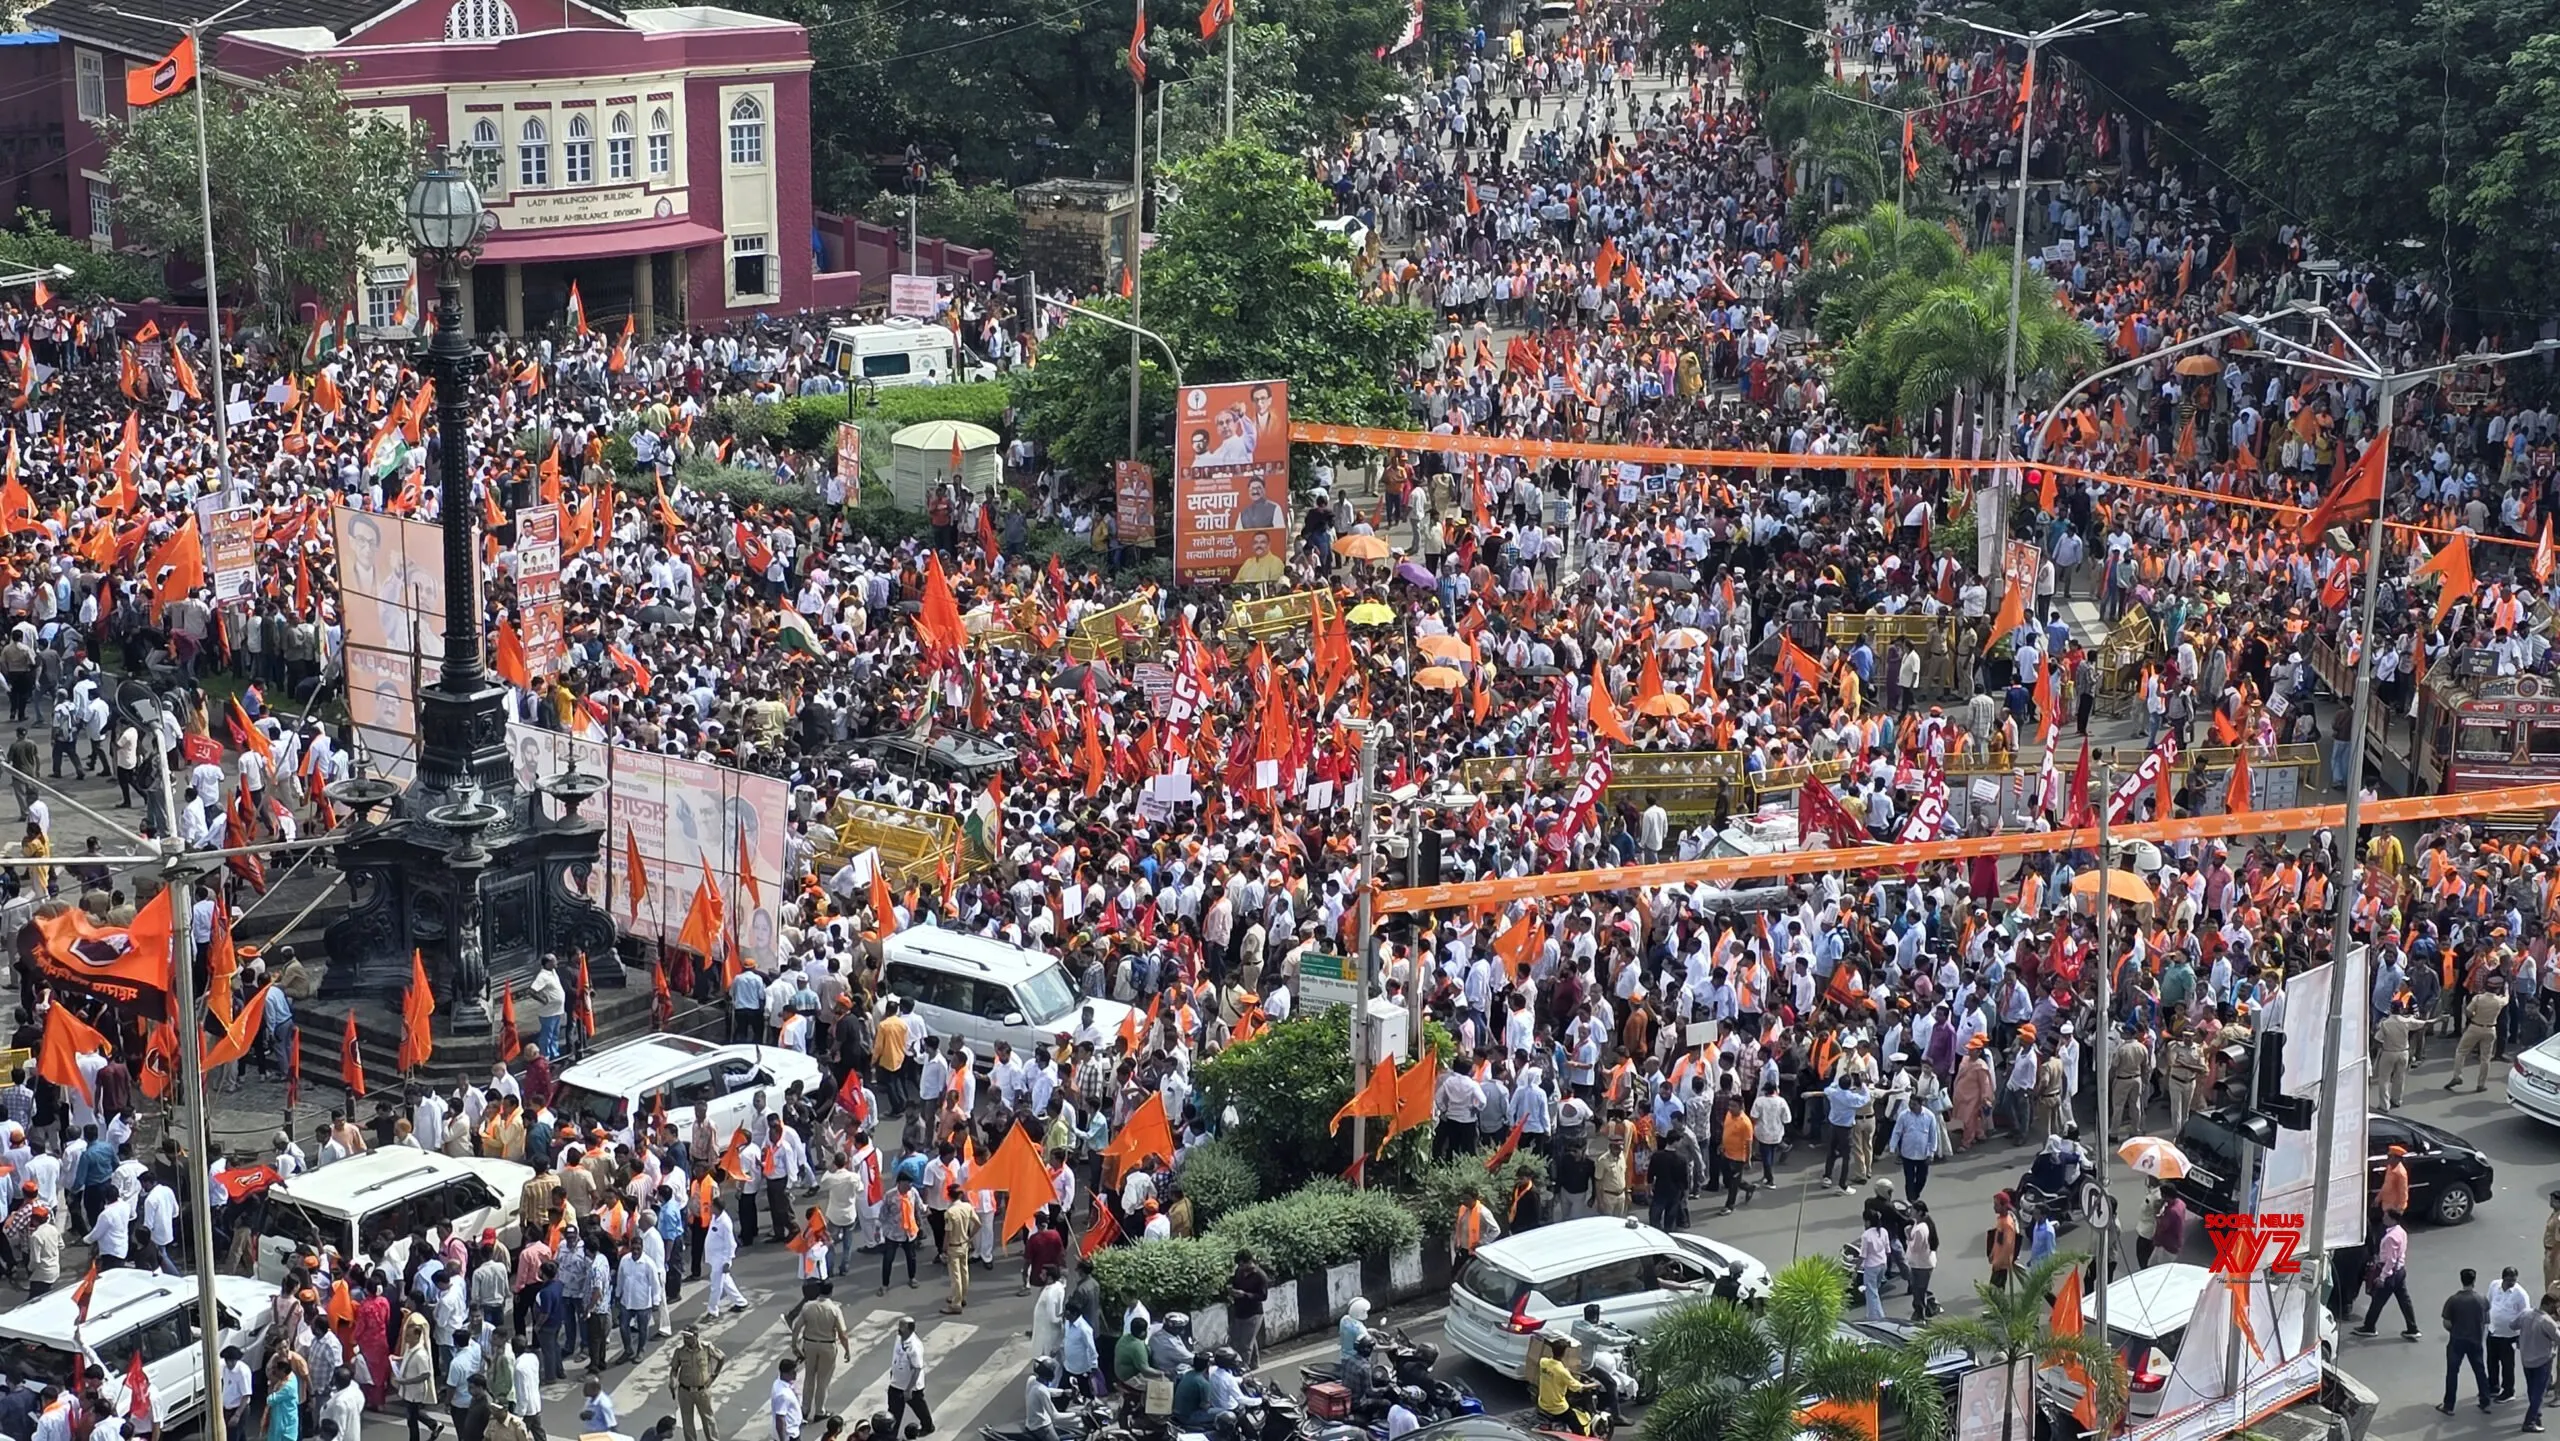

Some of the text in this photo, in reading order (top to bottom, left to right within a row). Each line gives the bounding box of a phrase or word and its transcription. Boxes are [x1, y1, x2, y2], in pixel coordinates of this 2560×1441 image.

[527, 191, 634, 207] LADY WILLINGDON BUILDING
[520, 207, 642, 225] THE PARSI AMBULANCE DIVISION
[1187, 491, 1239, 511] सत्याचा
[1195, 507, 1231, 530] मोर्चा
